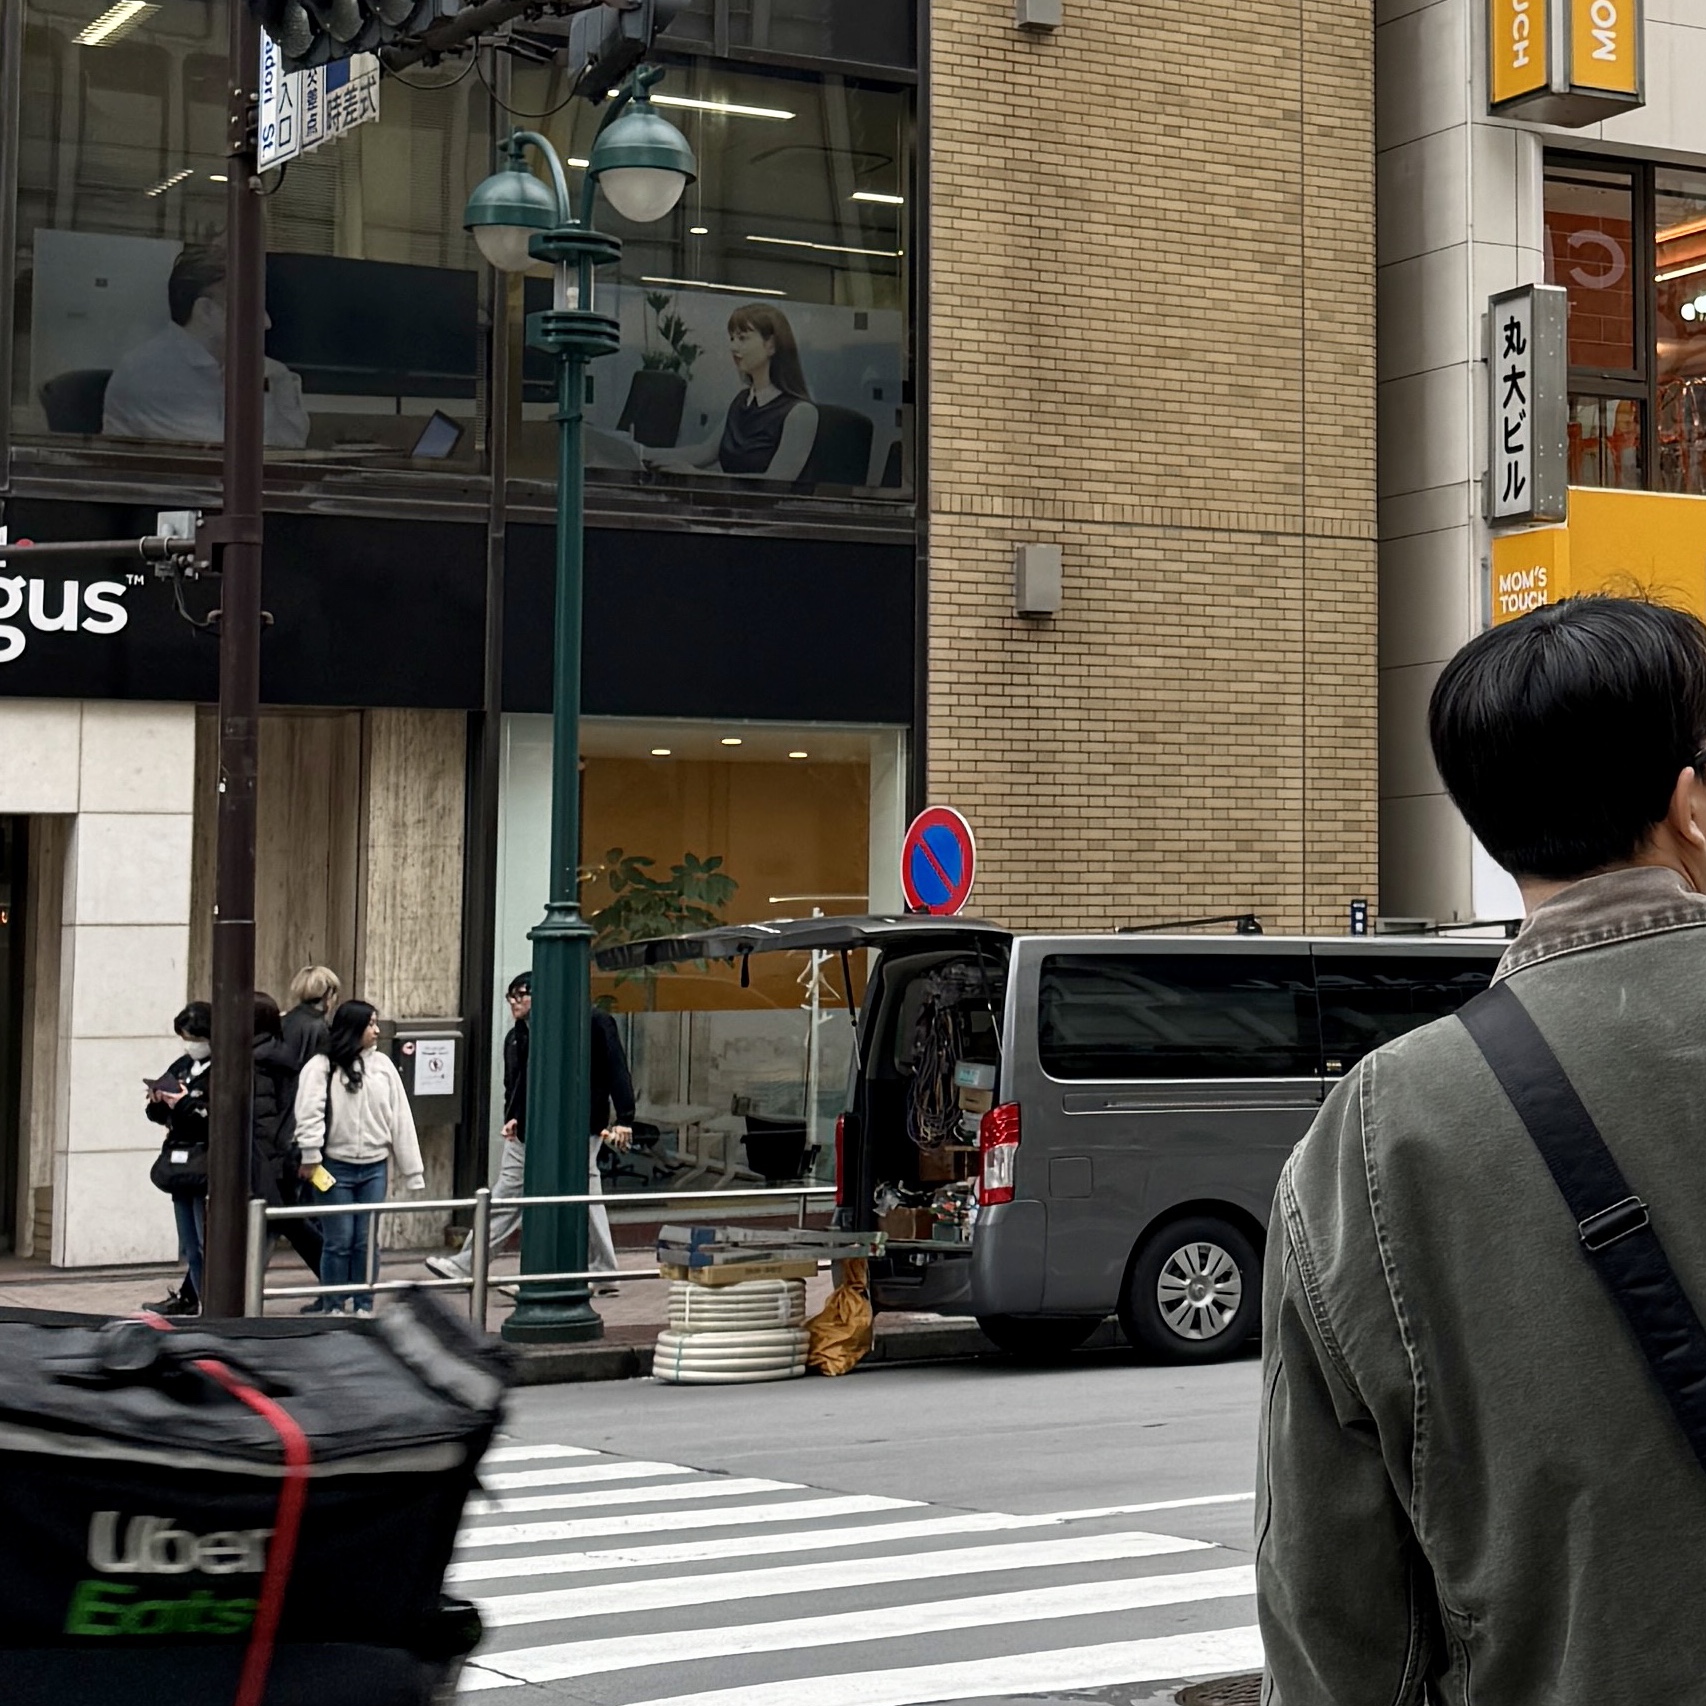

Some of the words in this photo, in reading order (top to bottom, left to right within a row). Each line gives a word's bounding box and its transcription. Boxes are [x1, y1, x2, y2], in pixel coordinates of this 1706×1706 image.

[1503, 315, 1526, 502] 丸大ビル
[1499, 565, 1548, 594] MOM'S
[1499, 589, 1548, 614] TOUCH
[86, 1510, 277, 1574] Uber
